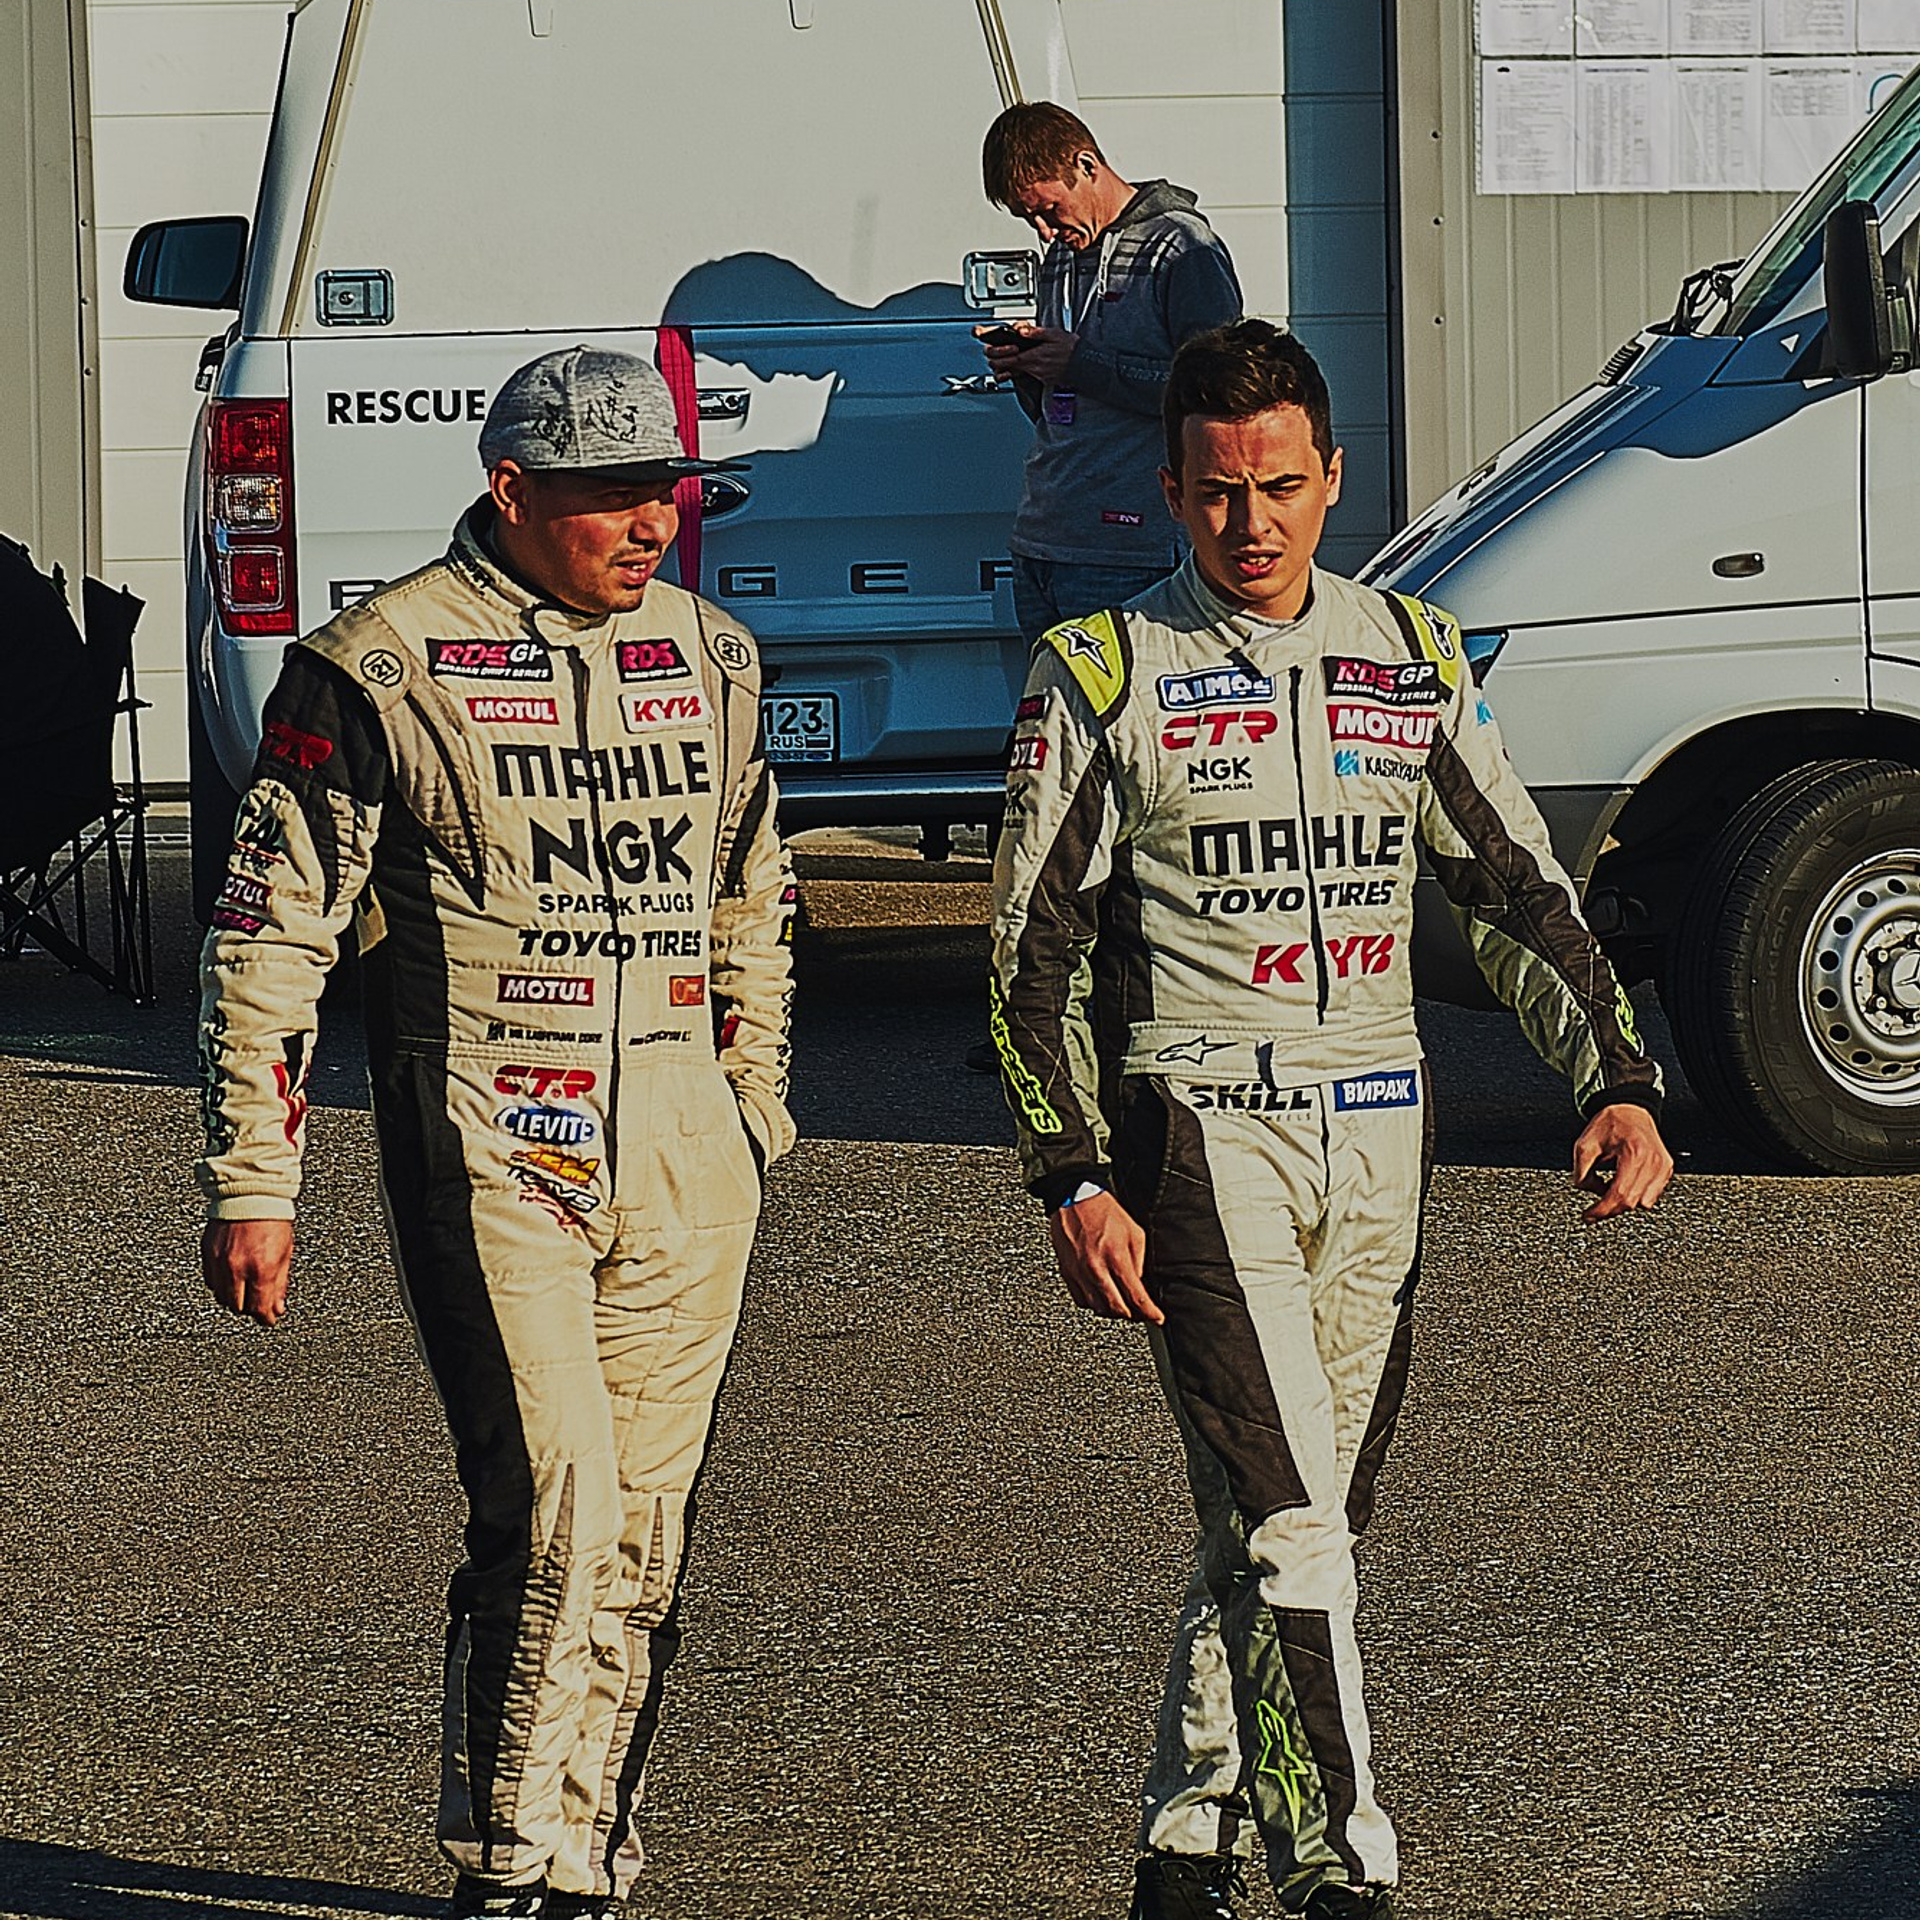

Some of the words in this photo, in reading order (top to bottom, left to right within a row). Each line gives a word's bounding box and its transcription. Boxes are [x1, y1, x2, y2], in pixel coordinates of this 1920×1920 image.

[327, 390, 486, 424] RESCUE
[439, 644, 511, 666] RDS
[622, 642, 675, 669] RDS
[1336, 661, 1399, 691] RDS
[1398, 665, 1434, 685] GP
[475, 700, 554, 720] MOTUL
[634, 695, 701, 722] KYB
[763, 701, 823, 735] 123
[770, 735, 805, 749] RUS
[1161, 710, 1278, 751] CTR
[490, 740, 711, 802] MAHLE
[1187, 756, 1253, 784] NGK
[1189, 785, 1219, 795] SPARK
[1222, 782, 1253, 792] PLUGS
[529, 812, 693, 884] NGK
[1190, 814, 1405, 876] MAHLE
[225, 876, 264, 906] OTUL
[538, 893, 636, 916] SPARK
[639, 892, 694, 914] PLUGS
[1196, 886, 1305, 916] TOYO
[1319, 879, 1398, 910] TIRES
[518, 929, 637, 962] TOYO
[641, 930, 702, 959] TIRES
[1251, 933, 1395, 985] KYB
[504, 979, 590, 1002] MOTUL
[1342, 1078, 1411, 1105] ВИРАЖ
[499, 1107, 596, 1142] CLEVITE
